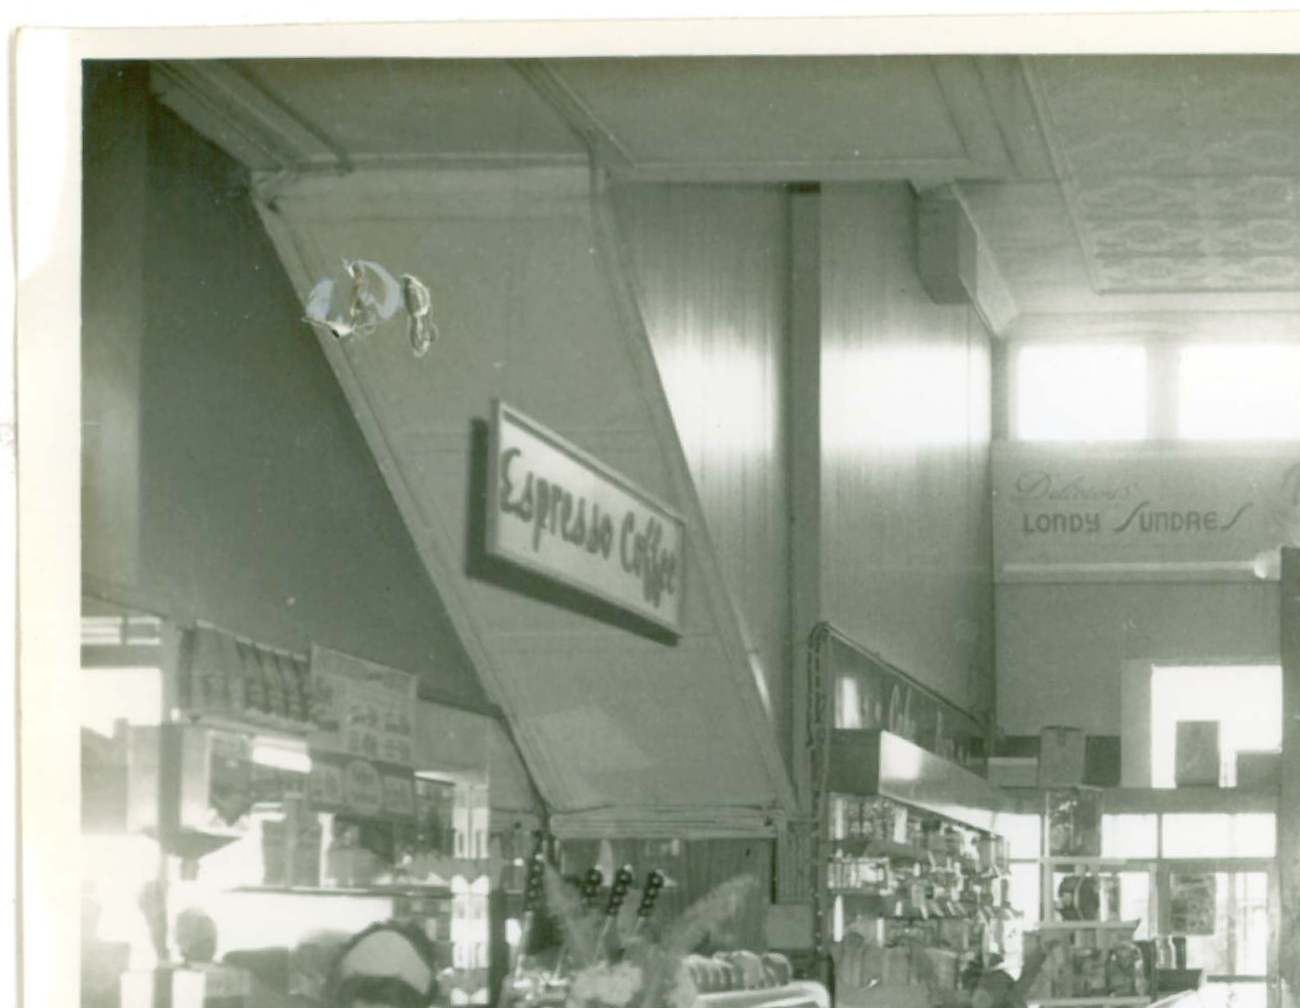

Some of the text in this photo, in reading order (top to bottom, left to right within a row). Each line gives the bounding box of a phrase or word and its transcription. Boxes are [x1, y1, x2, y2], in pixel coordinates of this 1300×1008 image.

[501, 447, 676, 608] Espresso Coffee
[1023, 512, 1100, 533] LONDY
